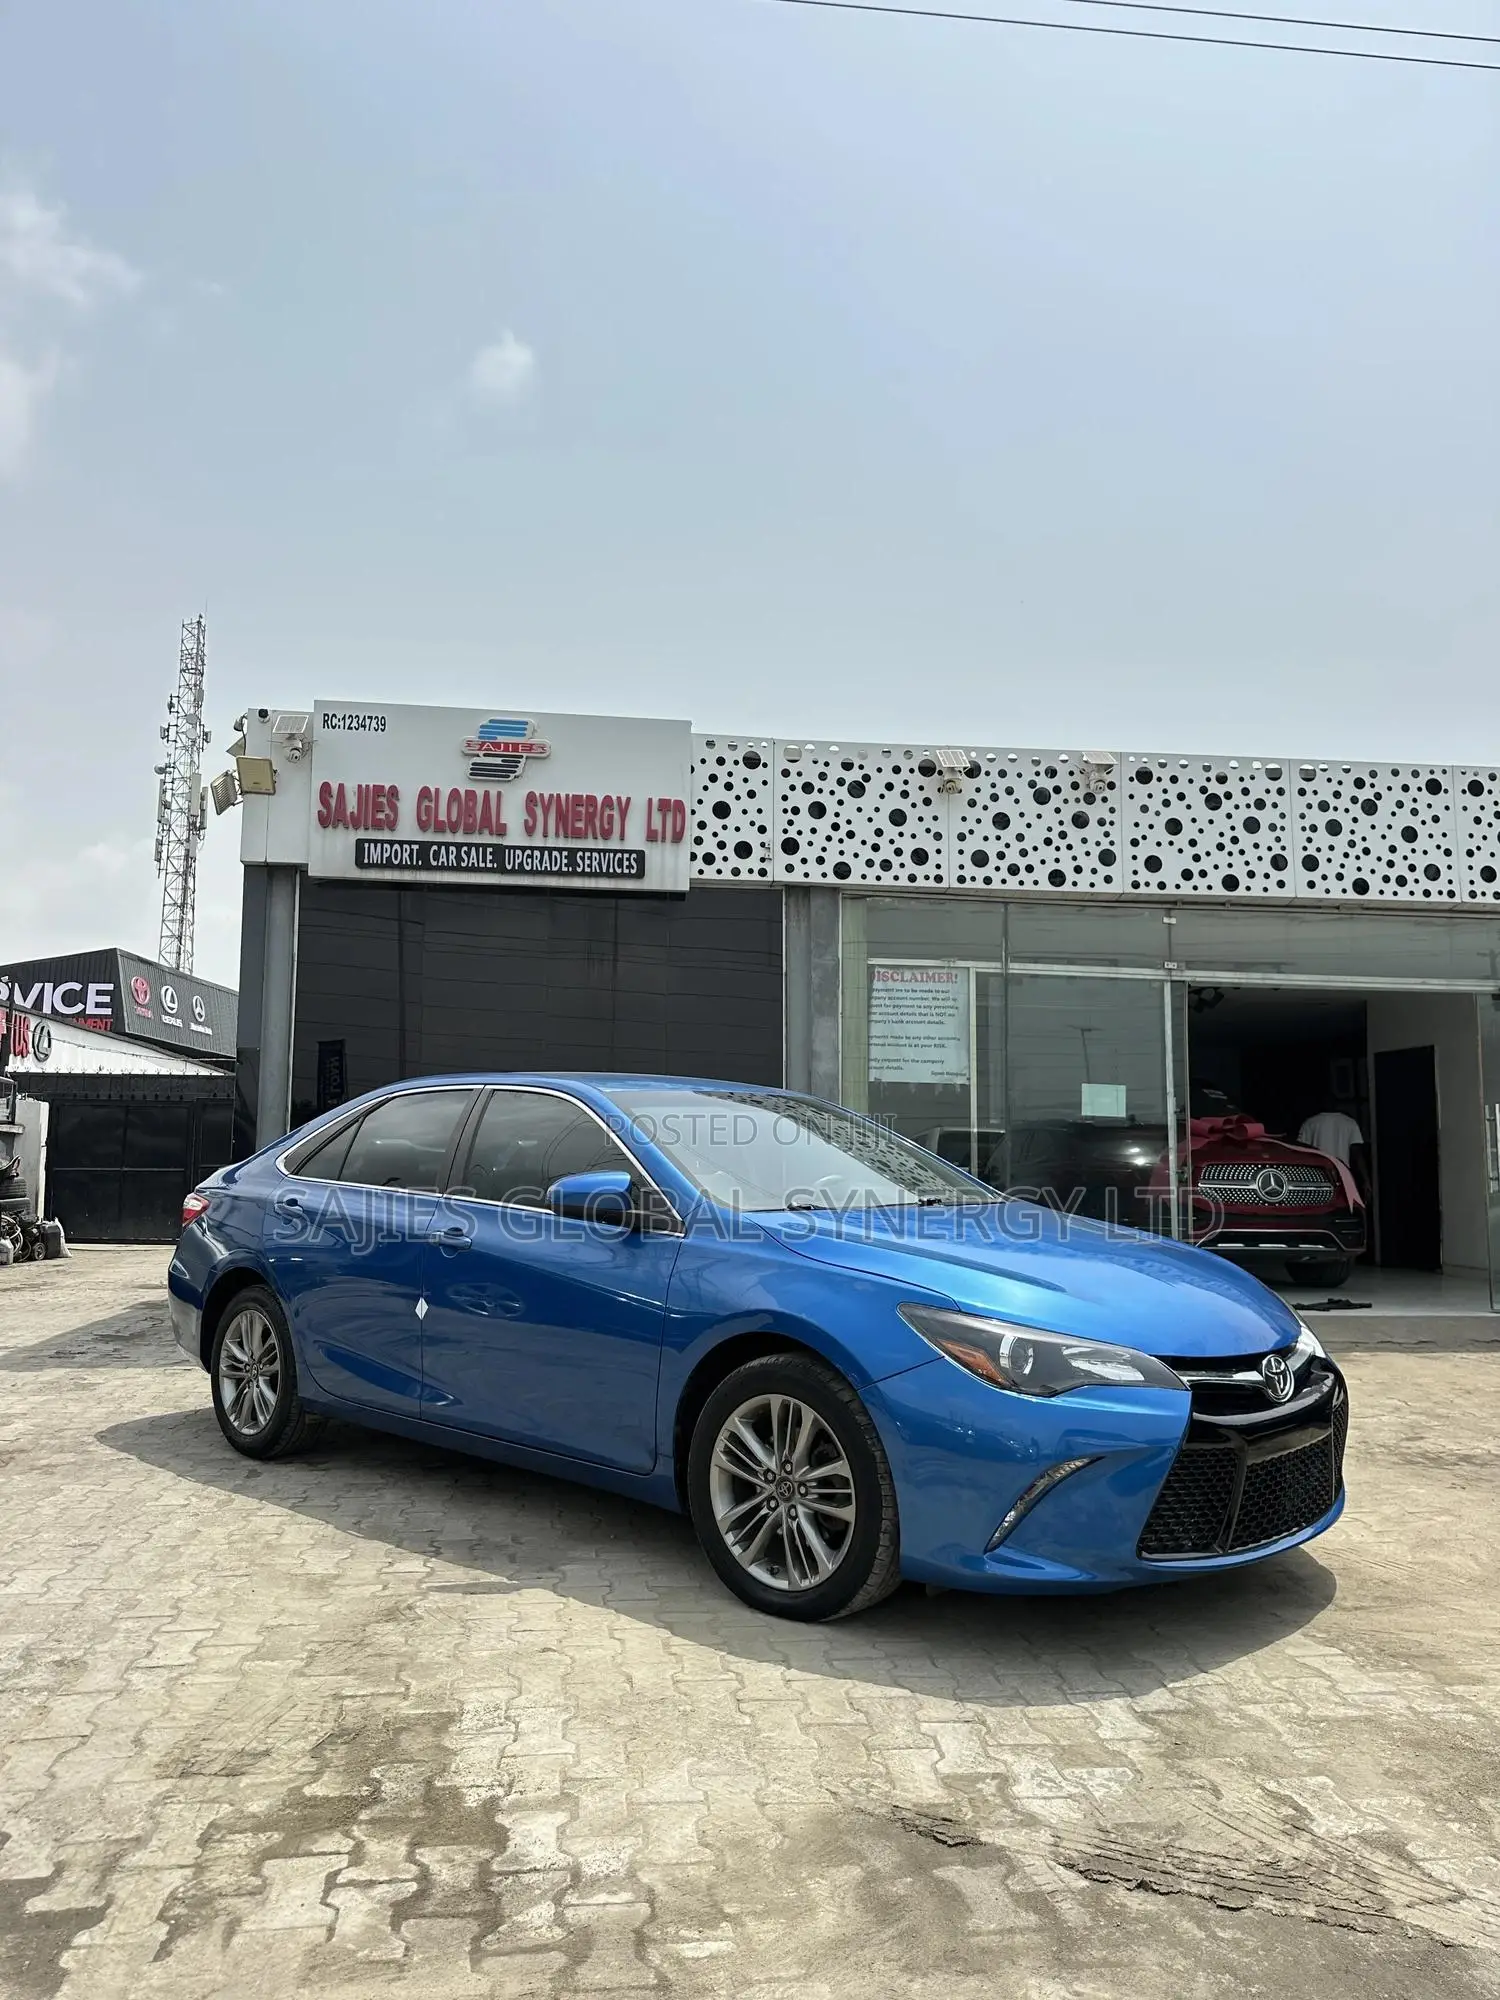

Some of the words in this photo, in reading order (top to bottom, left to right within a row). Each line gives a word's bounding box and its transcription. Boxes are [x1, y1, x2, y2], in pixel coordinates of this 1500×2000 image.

[322, 713, 386, 732] RC:1234739
[464, 740, 547, 754] SAJIES
[317, 781, 400, 831] SAJIES
[416, 785, 507, 836] GLOBAL
[524, 791, 631, 840] SYNERGY
[646, 797, 686, 843] LTD
[363, 842, 422, 866] IMPORT.
[429, 844, 457, 867] CAR
[460, 846, 497, 869] SALE.
[504, 848, 573, 873] UPGRADE.
[576, 850, 637, 875] SERVICES
